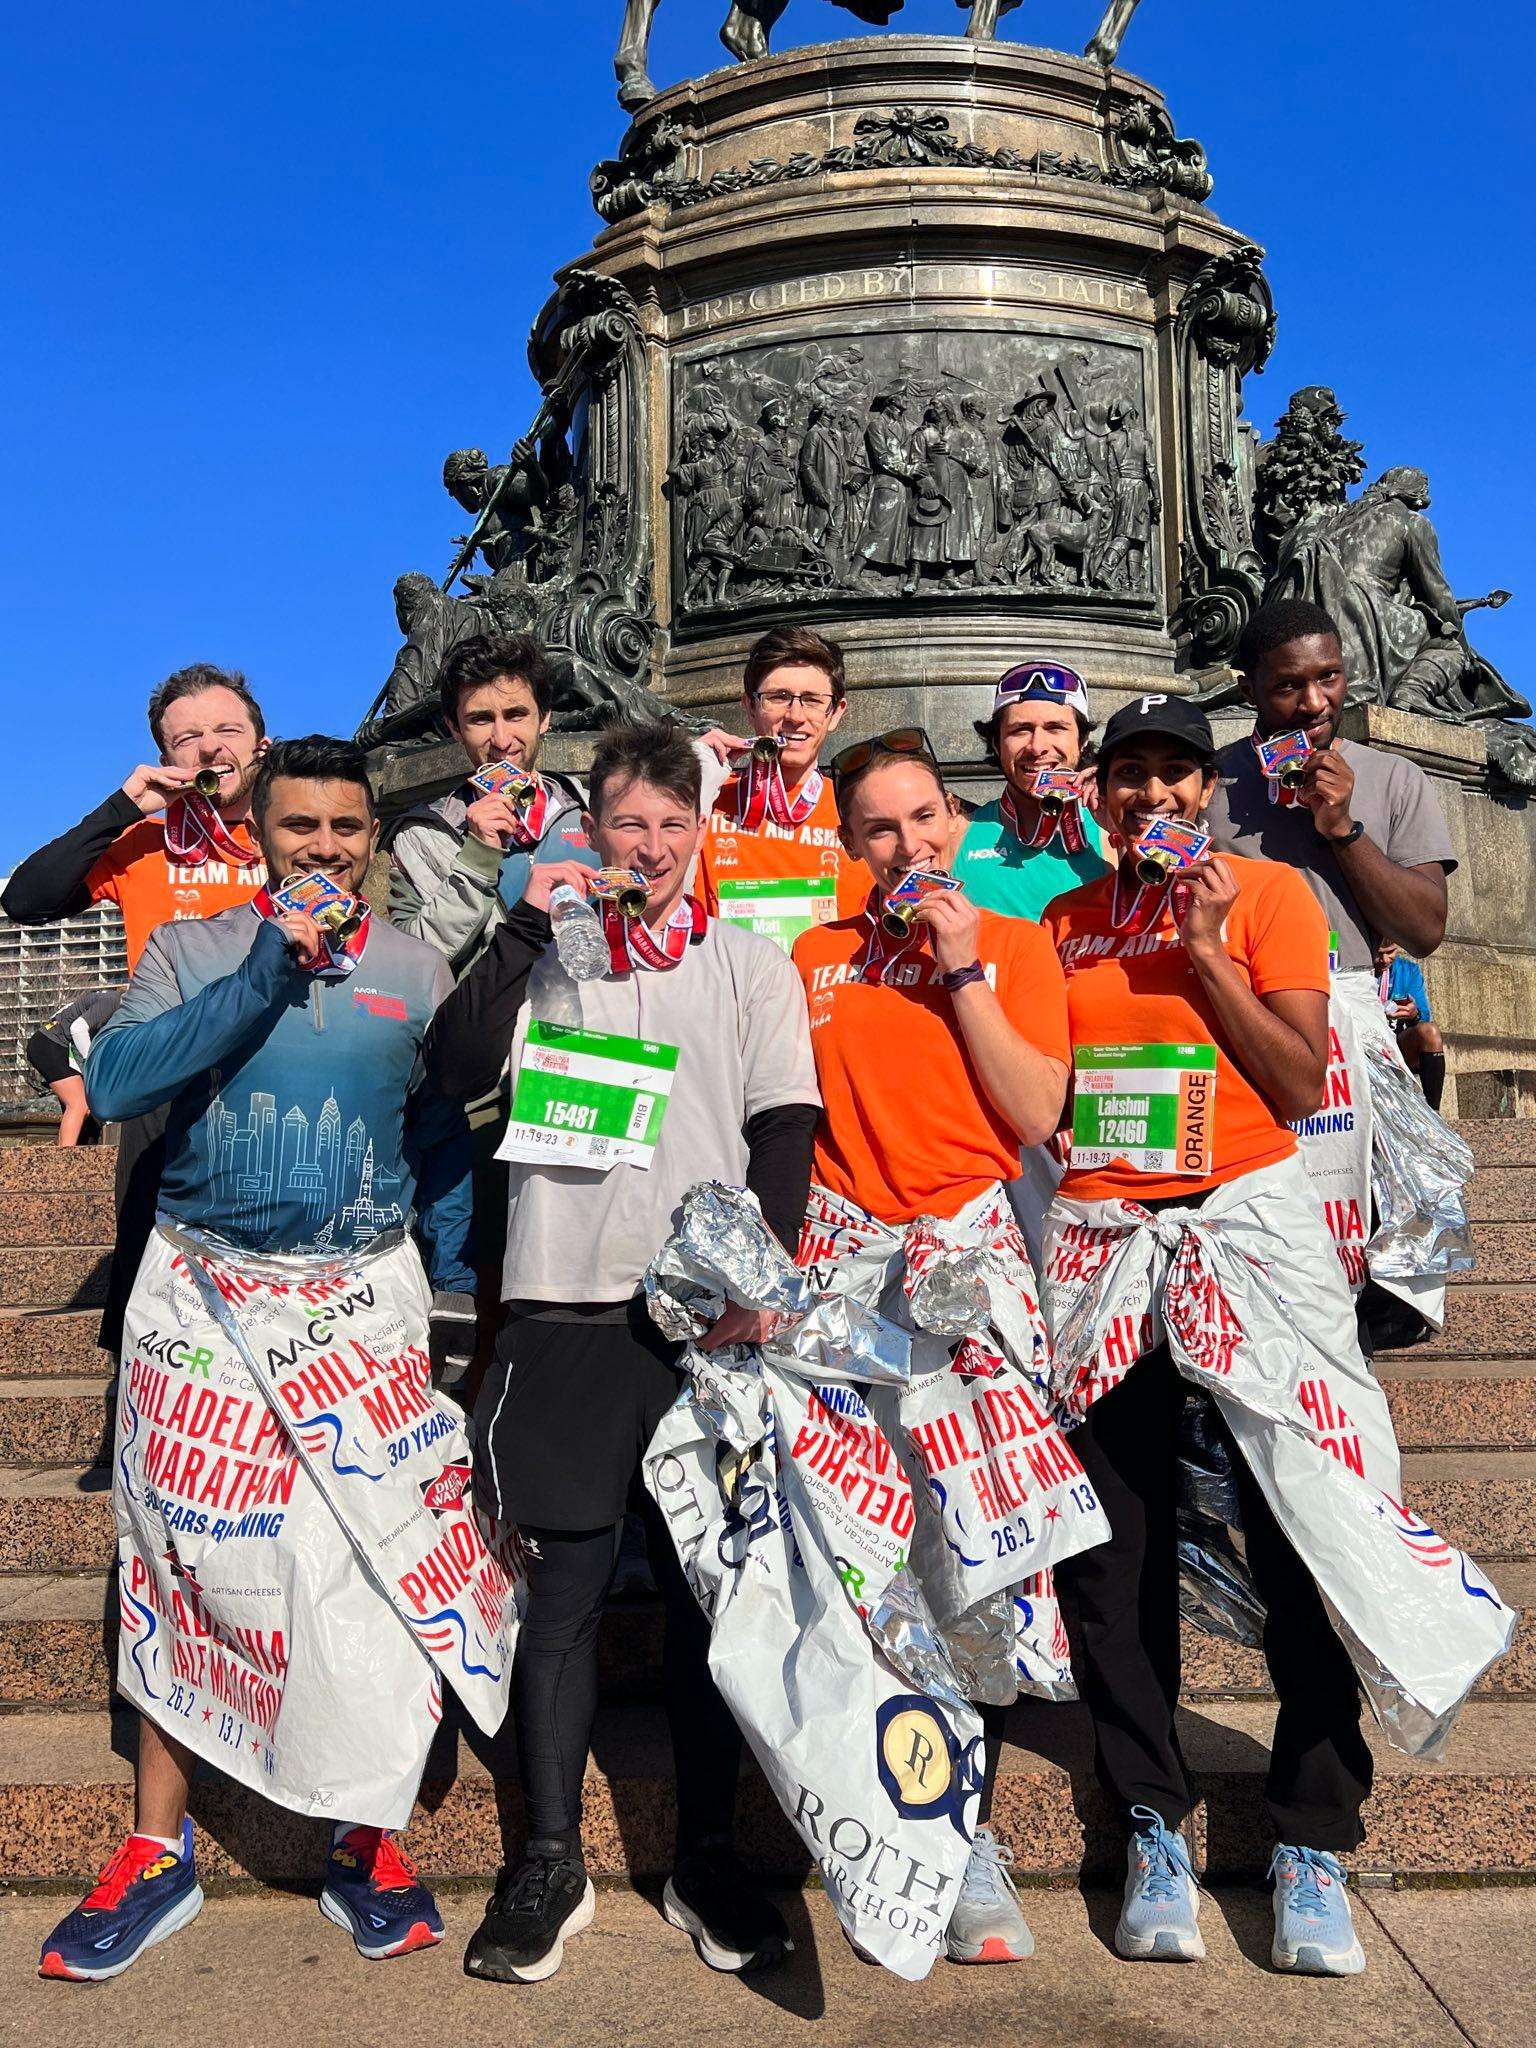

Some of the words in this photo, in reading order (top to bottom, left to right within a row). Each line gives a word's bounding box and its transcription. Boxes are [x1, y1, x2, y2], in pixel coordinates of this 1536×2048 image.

[681, 270, 845, 330] ERECTED
[861, 269, 906, 298] BY
[926, 266, 1008, 293] THE
[1028, 270, 1136, 312] STATE
[1140, 694, 1168, 715] P
[765, 820, 795, 841] AID
[967, 848, 1008, 861] HOKA
[166, 861, 229, 885] TEAM
[752, 918, 781, 934] Matt
[543, 1100, 600, 1132] 15481
[632, 1104, 648, 1130] Blue
[1097, 1096, 1150, 1117] Lakshmi
[1098, 1119, 1148, 1145] 12460
[1184, 1074, 1207, 1170] ORANGE
[514, 1128, 559, 1146] 11-19-23
[1077, 1152, 1111, 1164] 11-19-23
[1323, 1167, 1354, 1178] CHEESES
[136, 1330, 215, 1380] AACR
[218, 1371, 236, 1387] for
[917, 1372, 945, 1392] MEATS
[912, 1383, 1056, 1474] HILADEL
[387, 1436, 410, 1468] 30
[969, 1449, 1029, 1523] HALF
[848, 1514, 880, 1543] Cancer
[991, 1516, 1036, 1558] 26.2
[1069, 1483, 1098, 1514] 13
[378, 1518, 412, 1551] PREMIUM
[844, 1524, 895, 1569] American
[882, 1537, 901, 1556] for
[211, 1587, 243, 1597] ARTISAN
[244, 1587, 282, 1598] CHEESES
[166, 1682, 196, 1719] 26.2
[218, 1712, 244, 1750] 13.1
[904, 1727, 935, 1789] R
